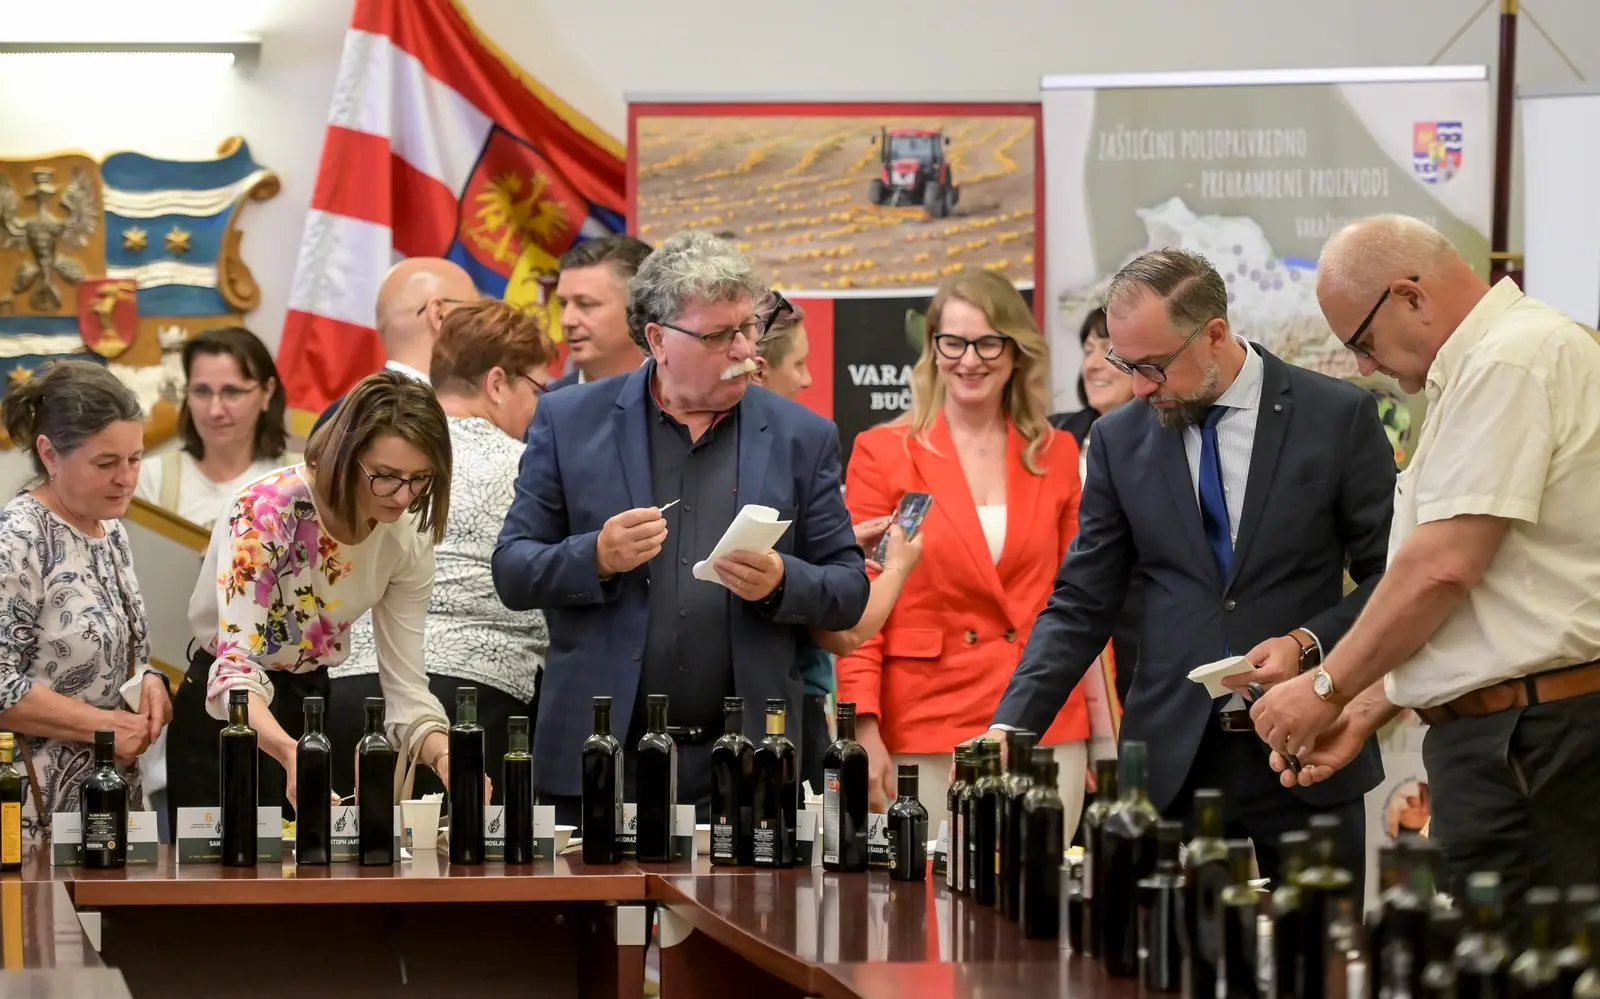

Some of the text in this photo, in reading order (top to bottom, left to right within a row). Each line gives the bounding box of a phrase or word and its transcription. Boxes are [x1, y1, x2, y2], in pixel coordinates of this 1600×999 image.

[1098, 124, 1307, 161] ZAŠTIĆENI POLJOPRIVREDNO
[1201, 169, 1303, 199] PREHRAMBENI
[1308, 167, 1389, 198] PROIZVODI
